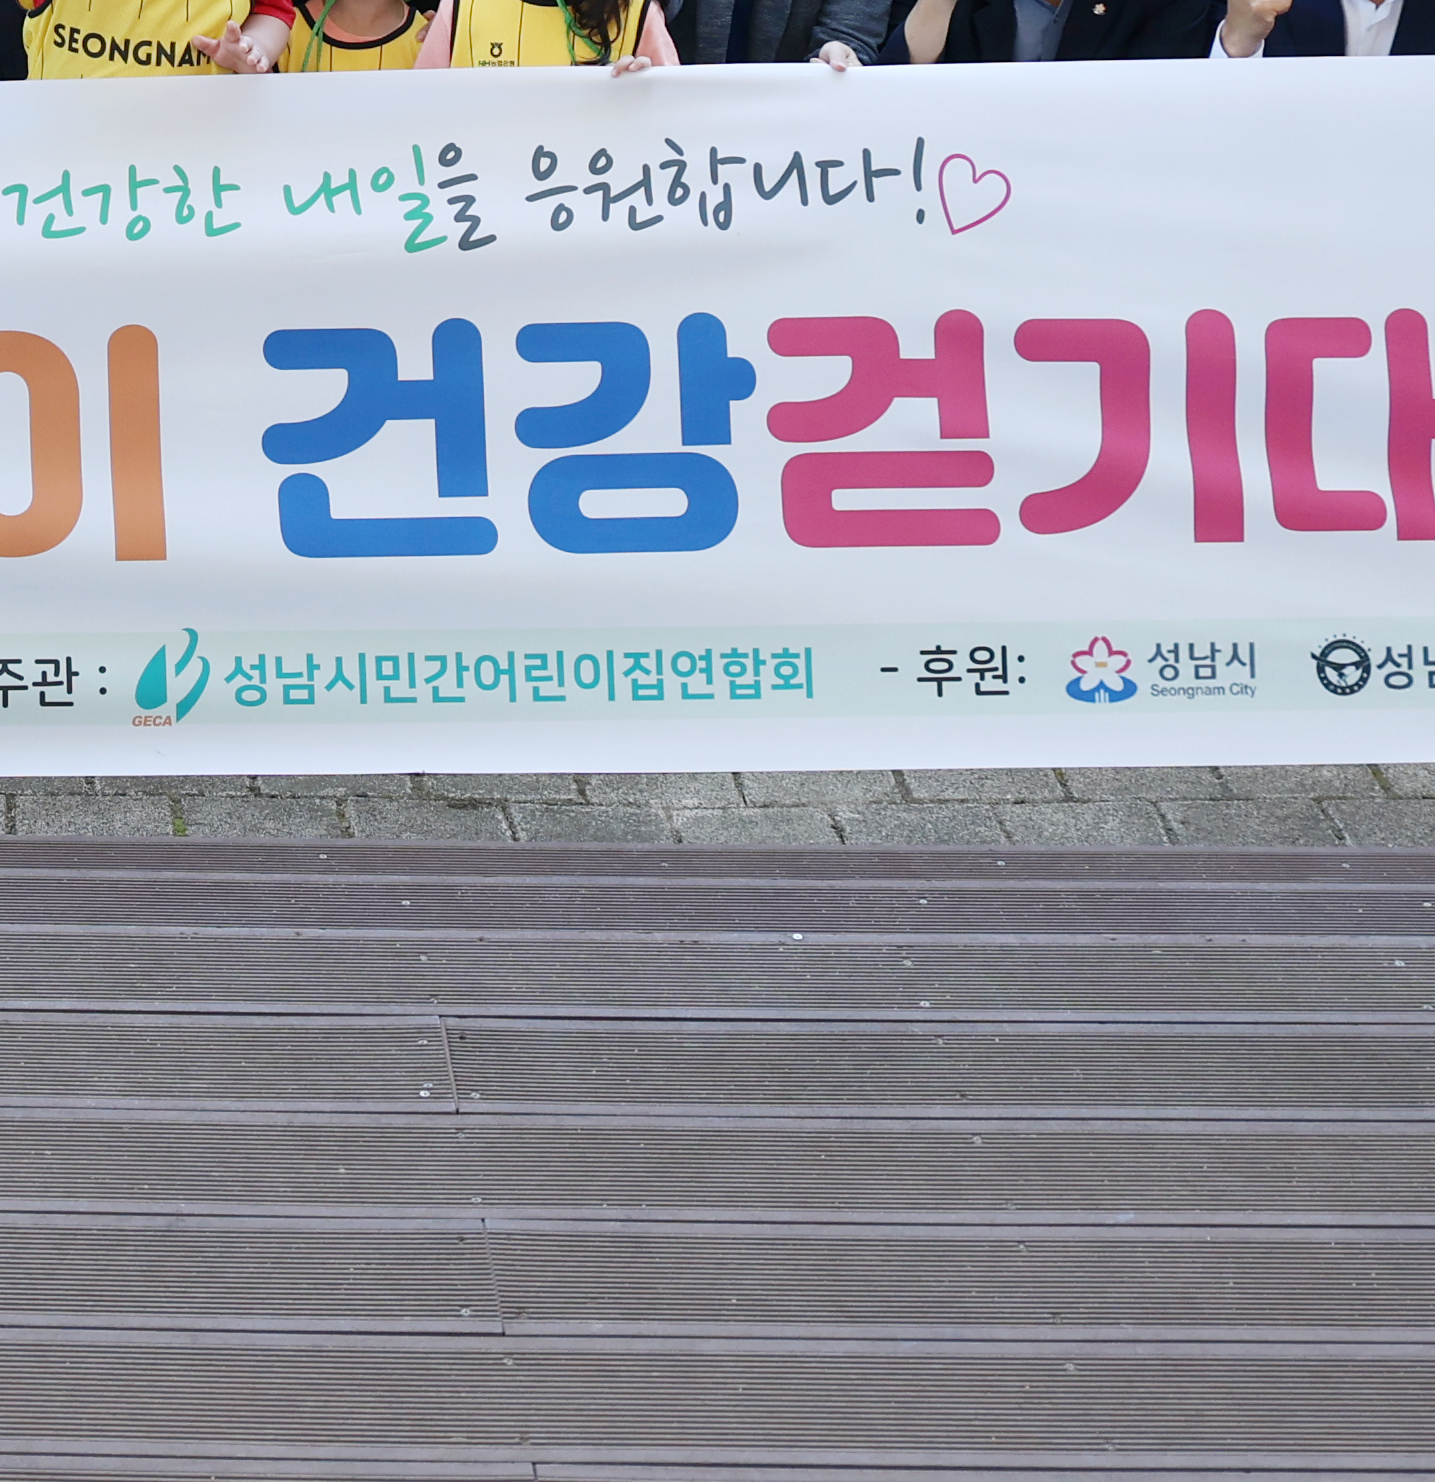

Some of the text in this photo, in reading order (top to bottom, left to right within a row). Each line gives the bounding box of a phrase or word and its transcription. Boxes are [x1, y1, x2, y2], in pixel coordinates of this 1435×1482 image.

[53, 22, 212, 67] SEONGNAM
[1, 164, 242, 242] 건강한
[283, 143, 497, 253] 내일을
[525, 137, 926, 233] 응원합니다!
[223, 646, 815, 707] 성남시민간어린이집연합회
[916, 645, 1026, 697] 후원:
[1147, 640, 1257, 682] 성남시
[1150, 682, 1257, 700] Seongnam City
[131, 714, 173, 727] GECA
